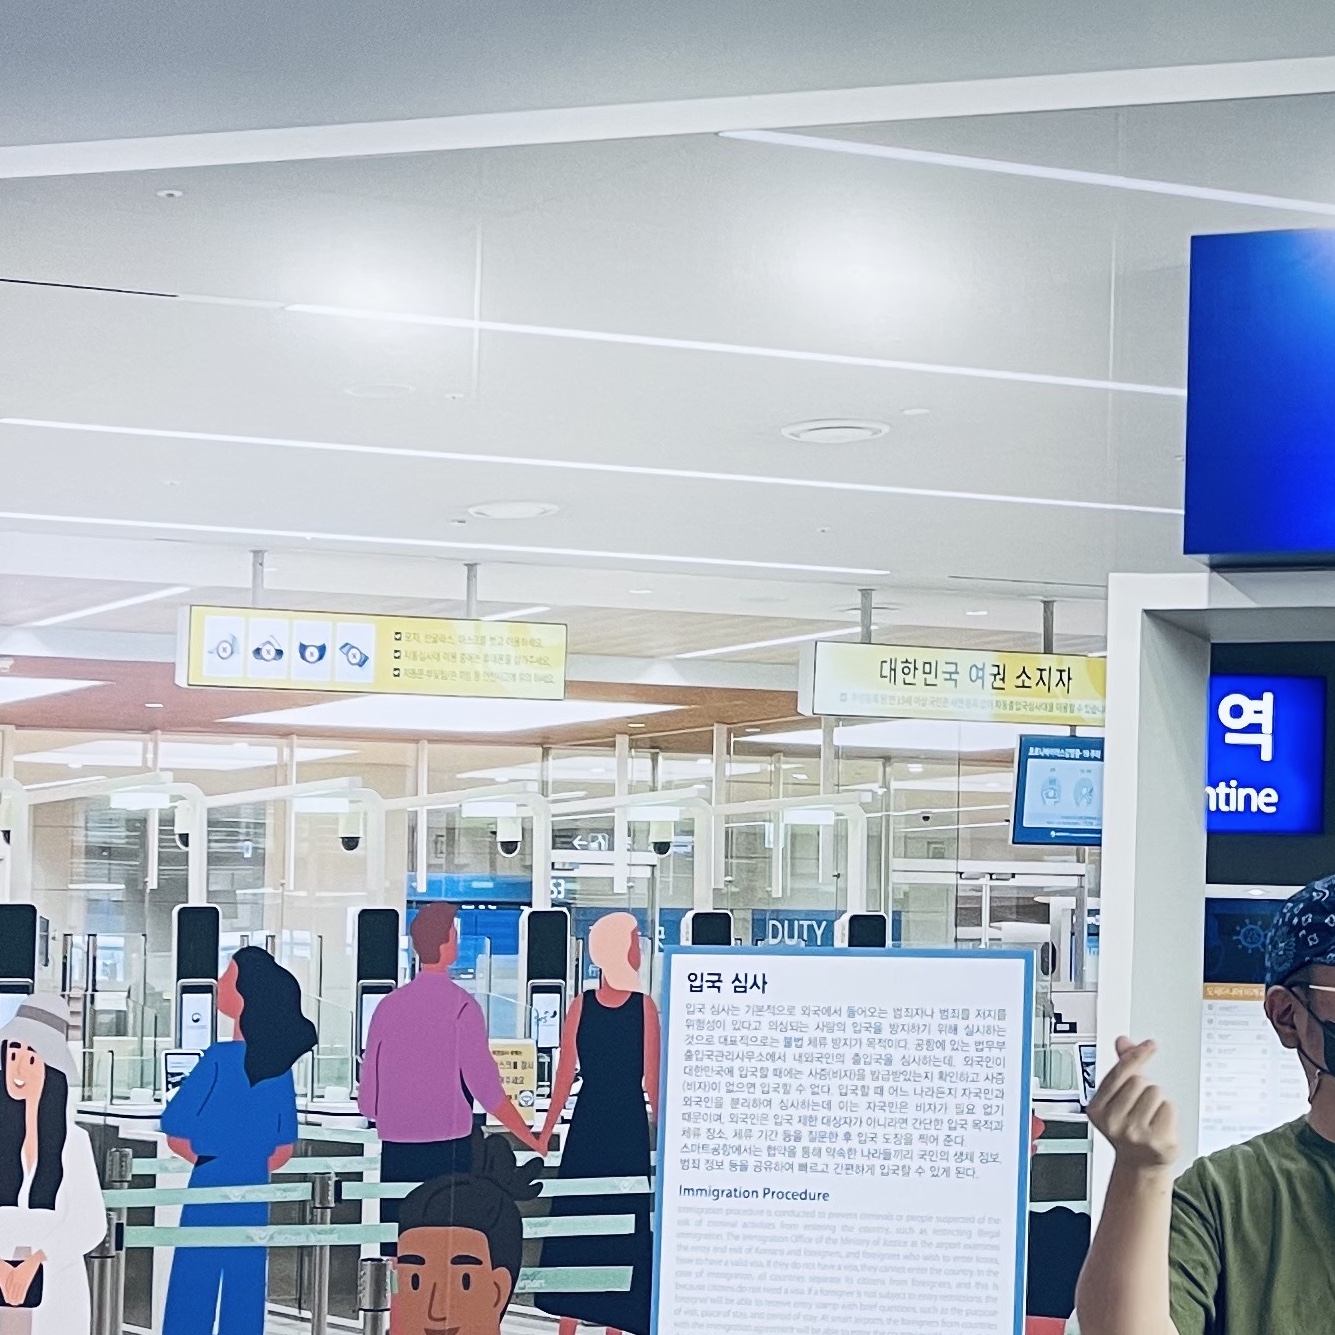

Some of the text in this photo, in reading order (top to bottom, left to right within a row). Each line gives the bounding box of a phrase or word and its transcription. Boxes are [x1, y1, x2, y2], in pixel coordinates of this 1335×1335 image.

[880, 657, 1072, 694] 대한민국 여권 소지자
[1218, 691, 1274, 762] 역
[768, 919, 827, 946] DUTY
[686, 972, 768, 995] 입국 심사
[678, 1183, 830, 1203] Immigration Procedure
